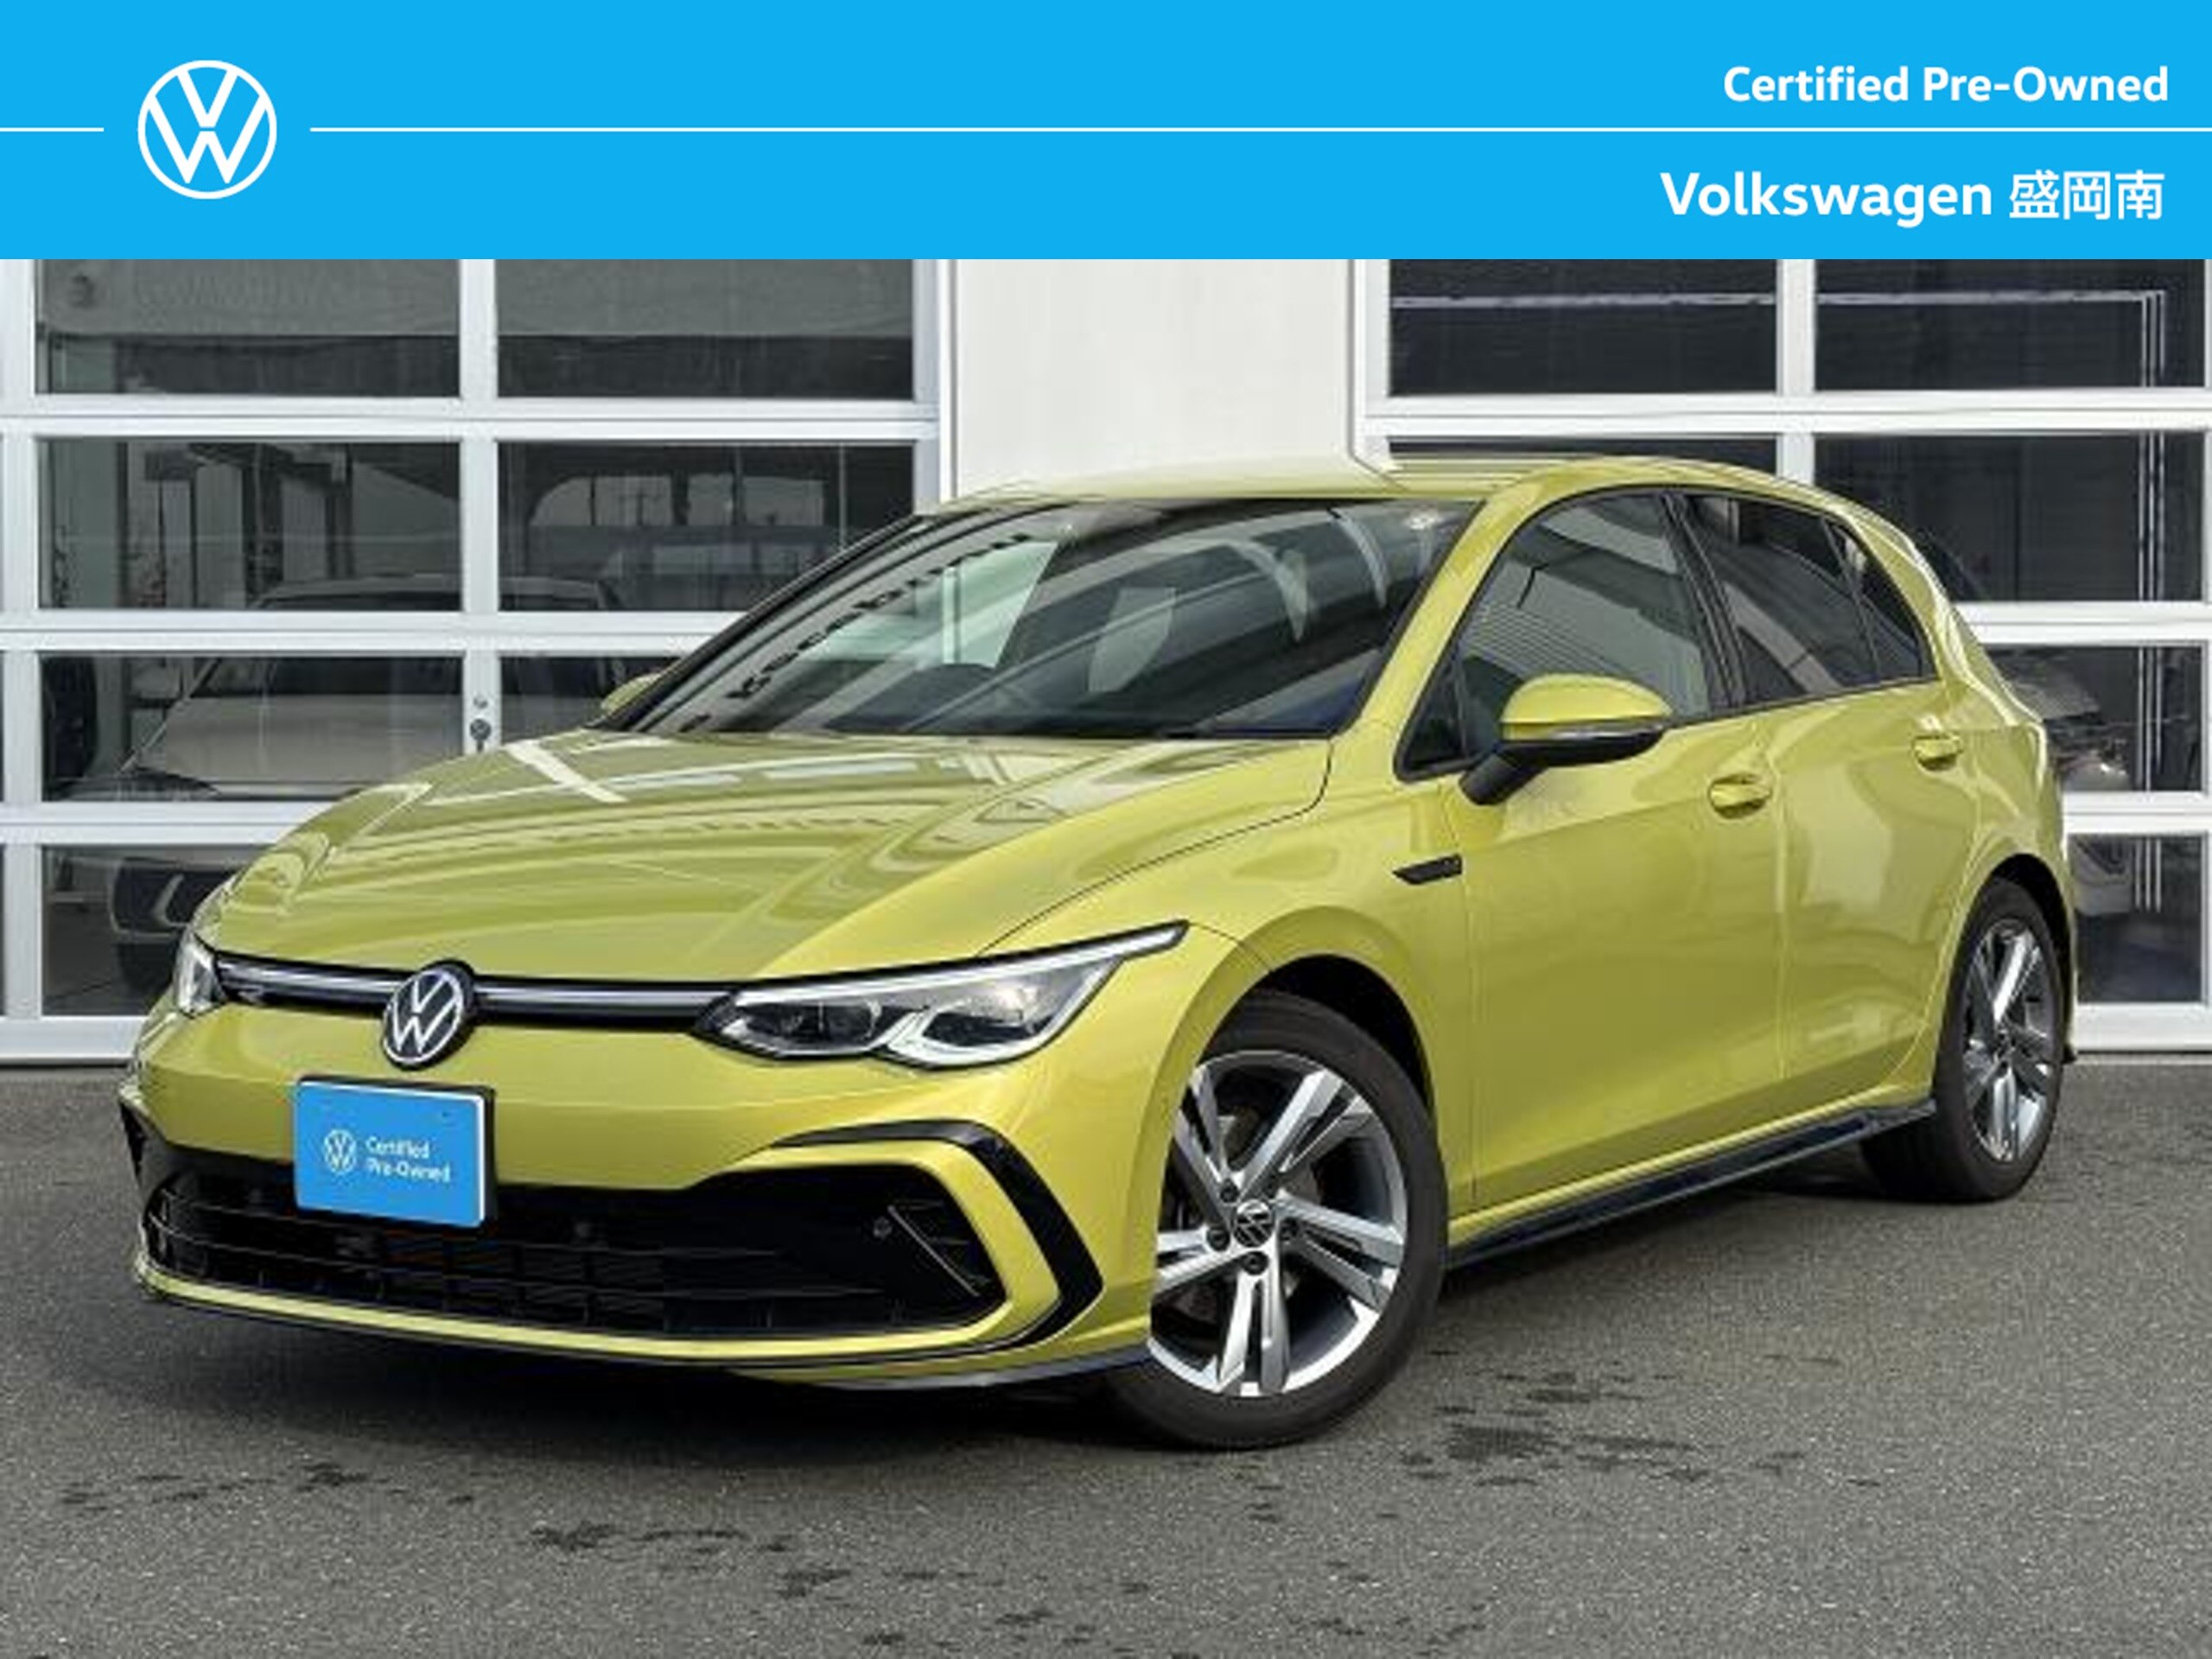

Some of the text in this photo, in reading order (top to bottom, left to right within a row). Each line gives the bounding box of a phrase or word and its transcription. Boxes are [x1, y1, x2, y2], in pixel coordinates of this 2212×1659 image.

[386, 970, 463, 1061] VW
[365, 1135, 430, 1160] Certified
[366, 1156, 451, 1184] Pre-Owned
